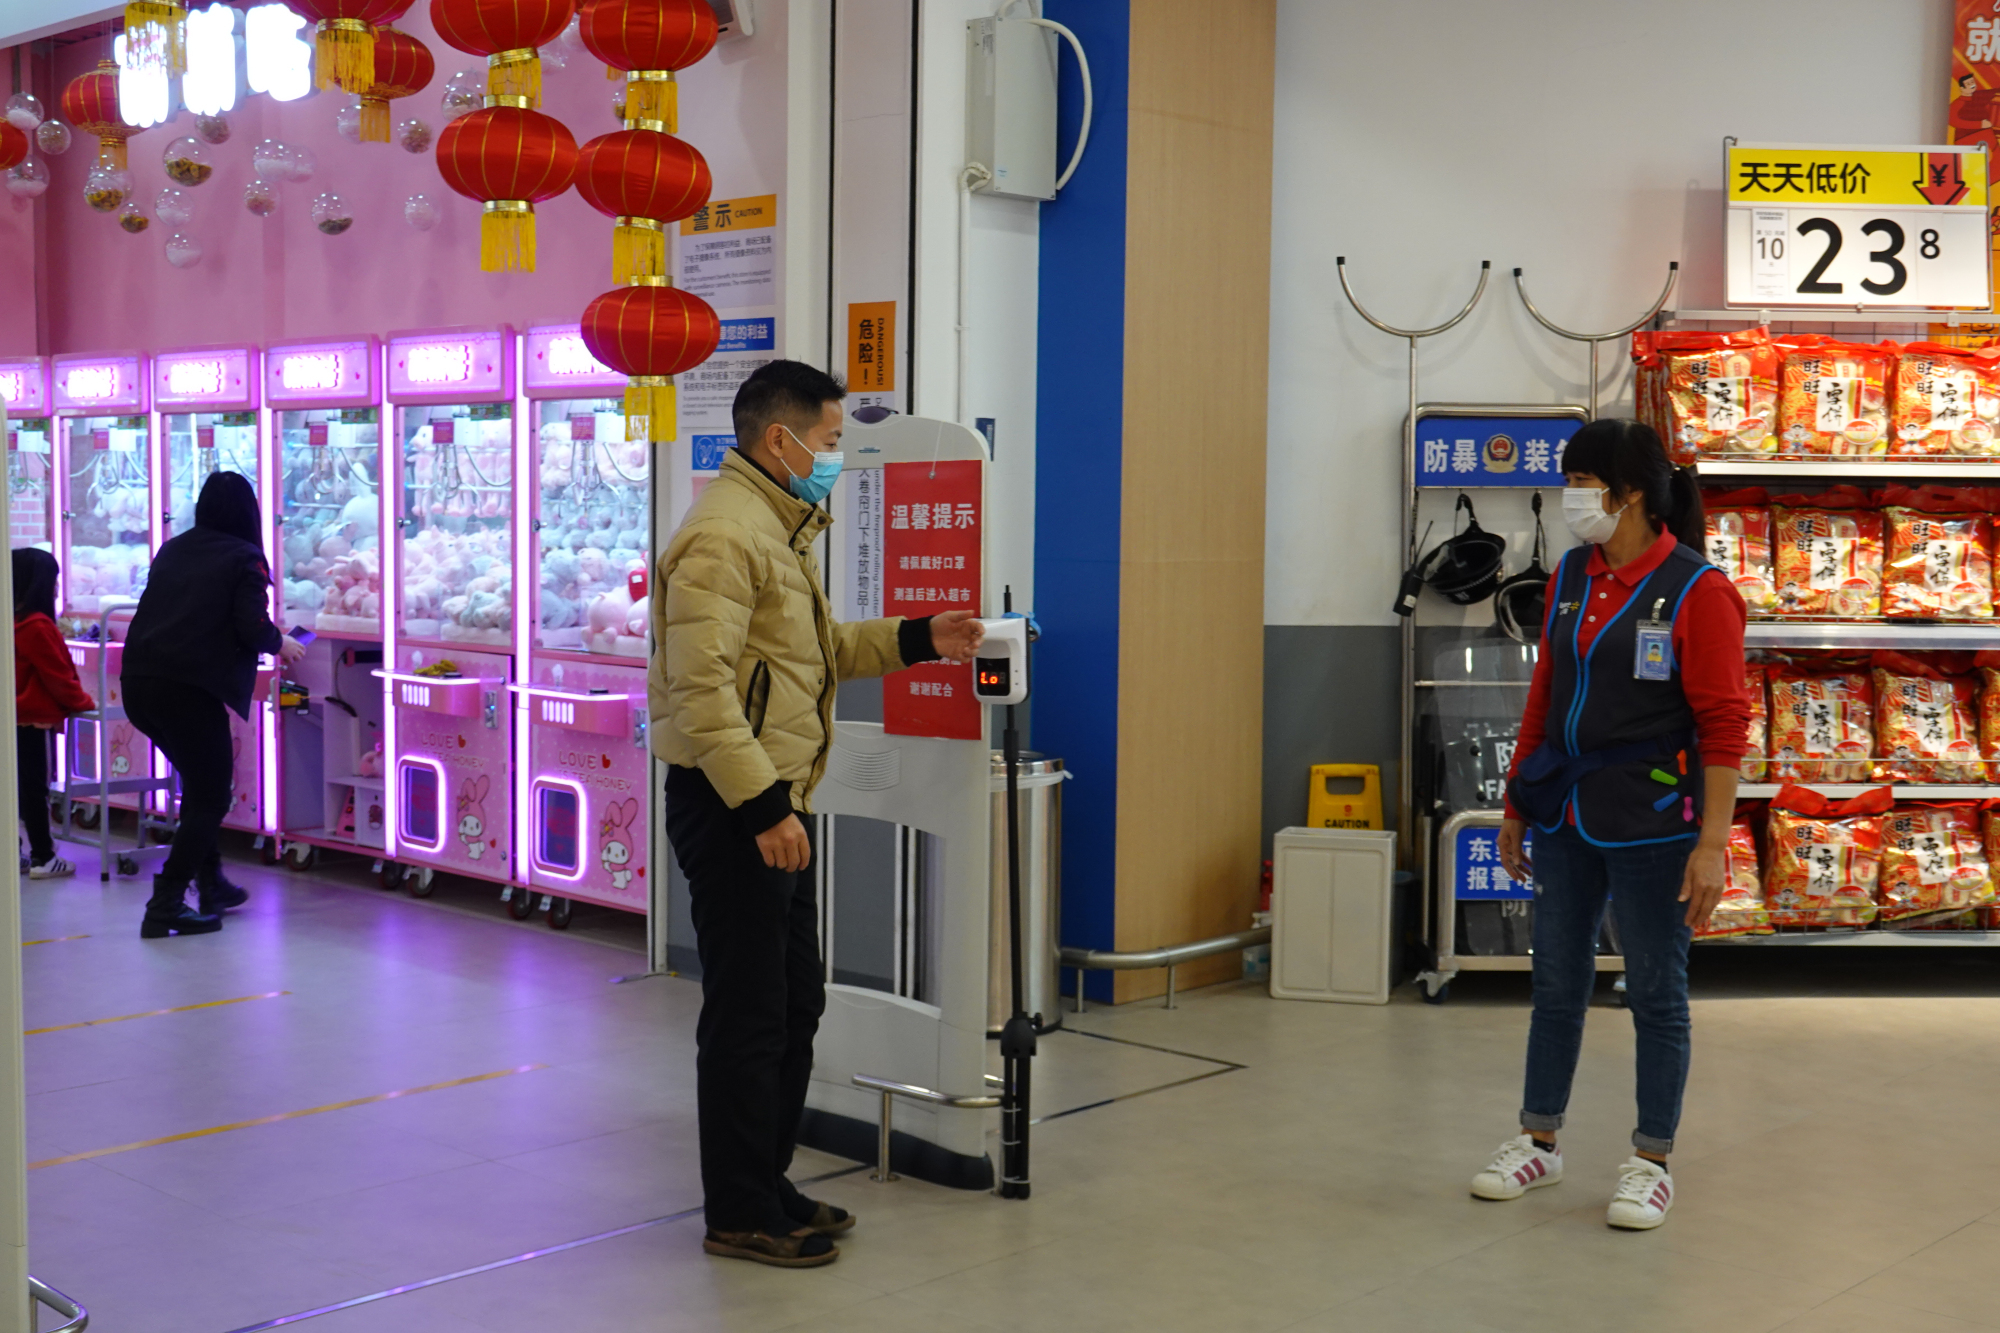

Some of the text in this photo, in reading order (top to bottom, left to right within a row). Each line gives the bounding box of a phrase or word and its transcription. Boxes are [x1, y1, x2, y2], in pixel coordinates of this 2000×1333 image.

[1739, 162, 1871, 194] 天天低价
[735, 207, 762, 218] CAUTION
[1757, 237, 1784, 260] 10
[1796, 217, 1940, 296] 23 8
[859, 319, 874, 385] 危险！
[877, 317, 885, 386] DANGEROUS!
[1424, 438, 1478, 473] 防暴
[891, 503, 975, 530] 温馨提示
[873, 513, 881, 553] fireproof
[872, 553, 880, 582] rolling
[899, 556, 965, 570] 请佩戴好口罩
[894, 588, 970, 602] 测温后进入超市
[909, 681, 953, 697] 谢谢配合
[421, 732, 454, 749] LOVE
[558, 751, 597, 769] LOVE
[1325, 819, 1370, 828] CAUTION
